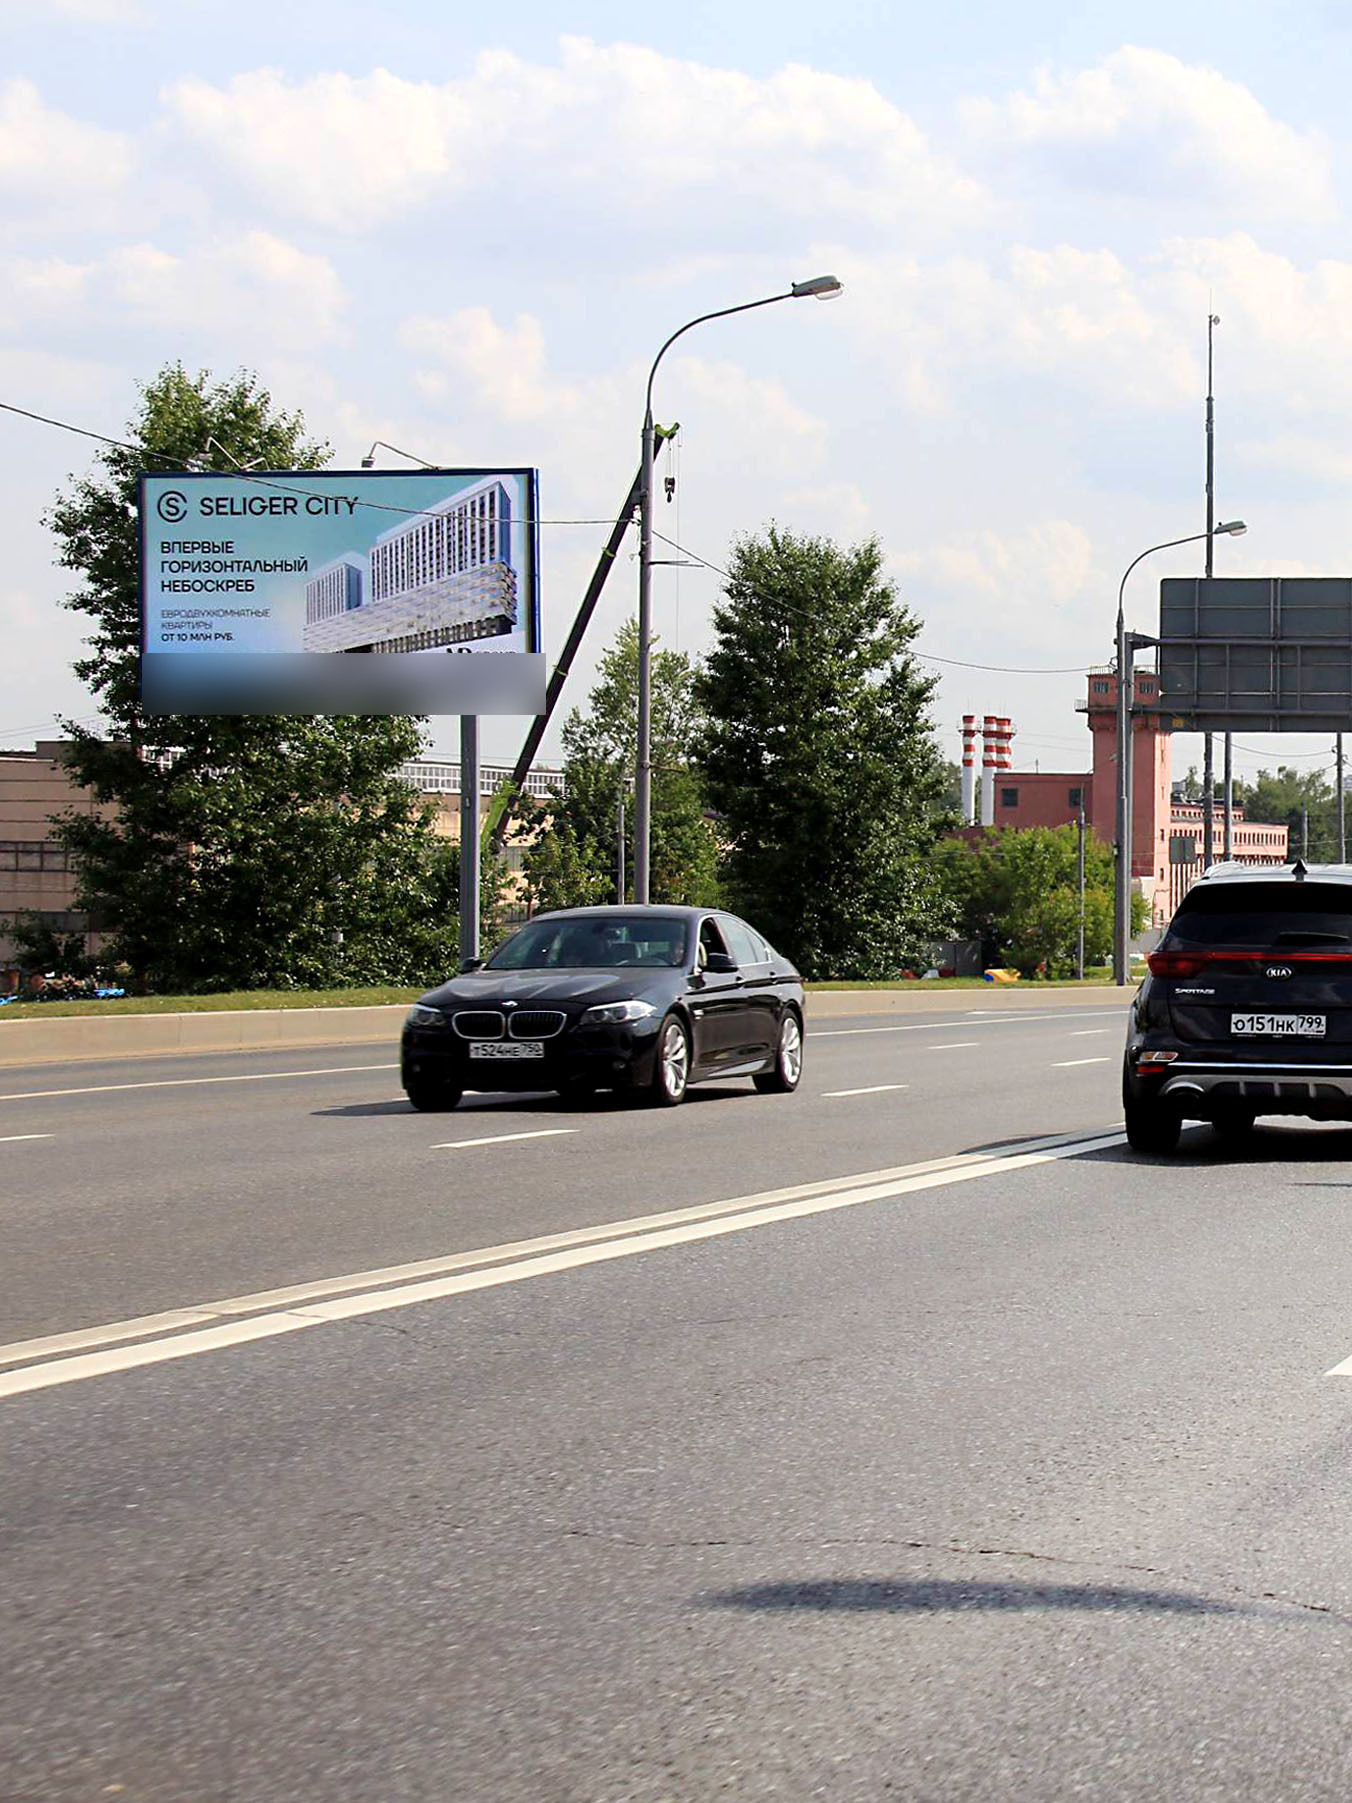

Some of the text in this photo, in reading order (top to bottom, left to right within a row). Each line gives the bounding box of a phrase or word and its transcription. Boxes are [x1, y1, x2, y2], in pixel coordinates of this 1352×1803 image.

[200, 497, 298, 516] SELIGER
[306, 497, 359, 516] CITY
[161, 541, 235, 554] ВПЕРВЫЕ
[161, 556, 308, 573] ГОРИЗОНТАЛЬНЫЙ
[161, 580, 255, 593] НЕБОСКРЕБ
[161, 608, 271, 619] ЕВРОДВУХКОМНАТНЫЕ
[161, 621, 213, 631] КВАРТИРЫ
[161, 633, 234, 642] ОТ 10 МЛН РУБ.
